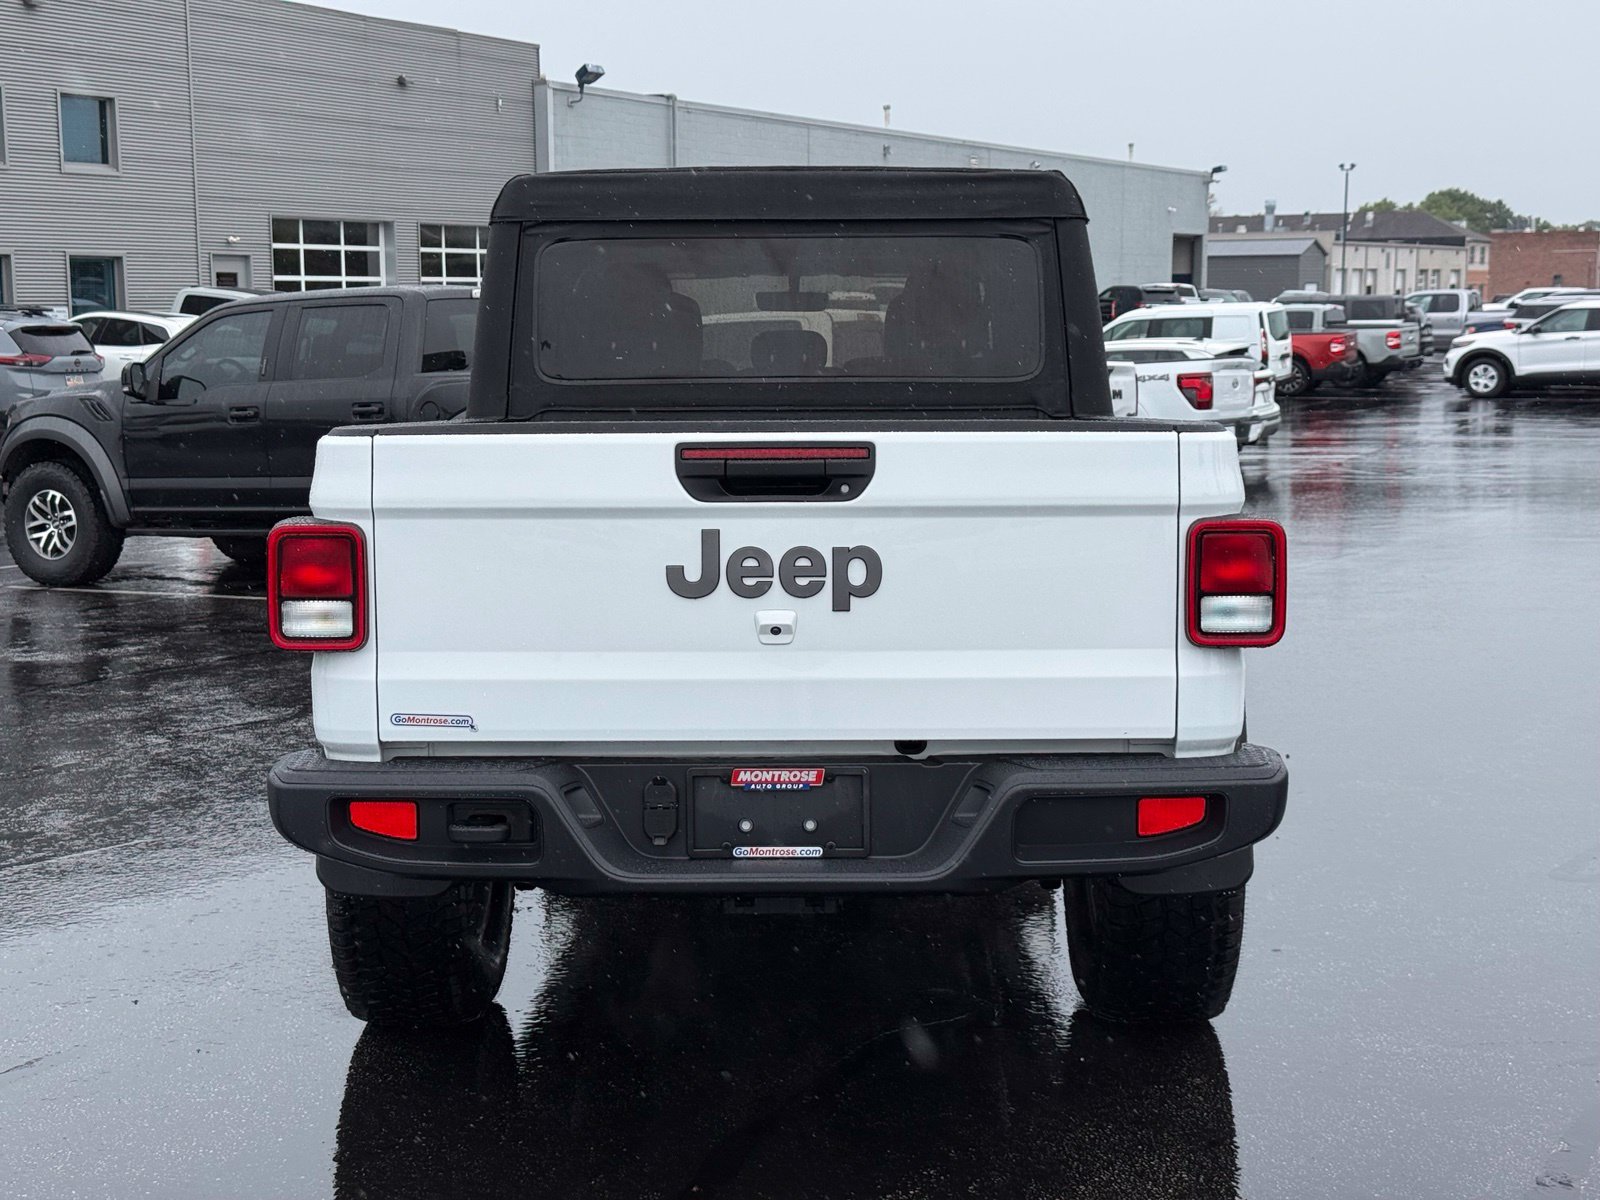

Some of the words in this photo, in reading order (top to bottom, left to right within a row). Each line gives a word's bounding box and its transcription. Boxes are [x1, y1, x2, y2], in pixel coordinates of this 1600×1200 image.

[665, 528, 883, 612] Jeep
[394, 715, 470, 726] GoMontrose.com
[737, 770, 818, 782] MONTROSE
[734, 847, 821, 856] GoMontrose.com
